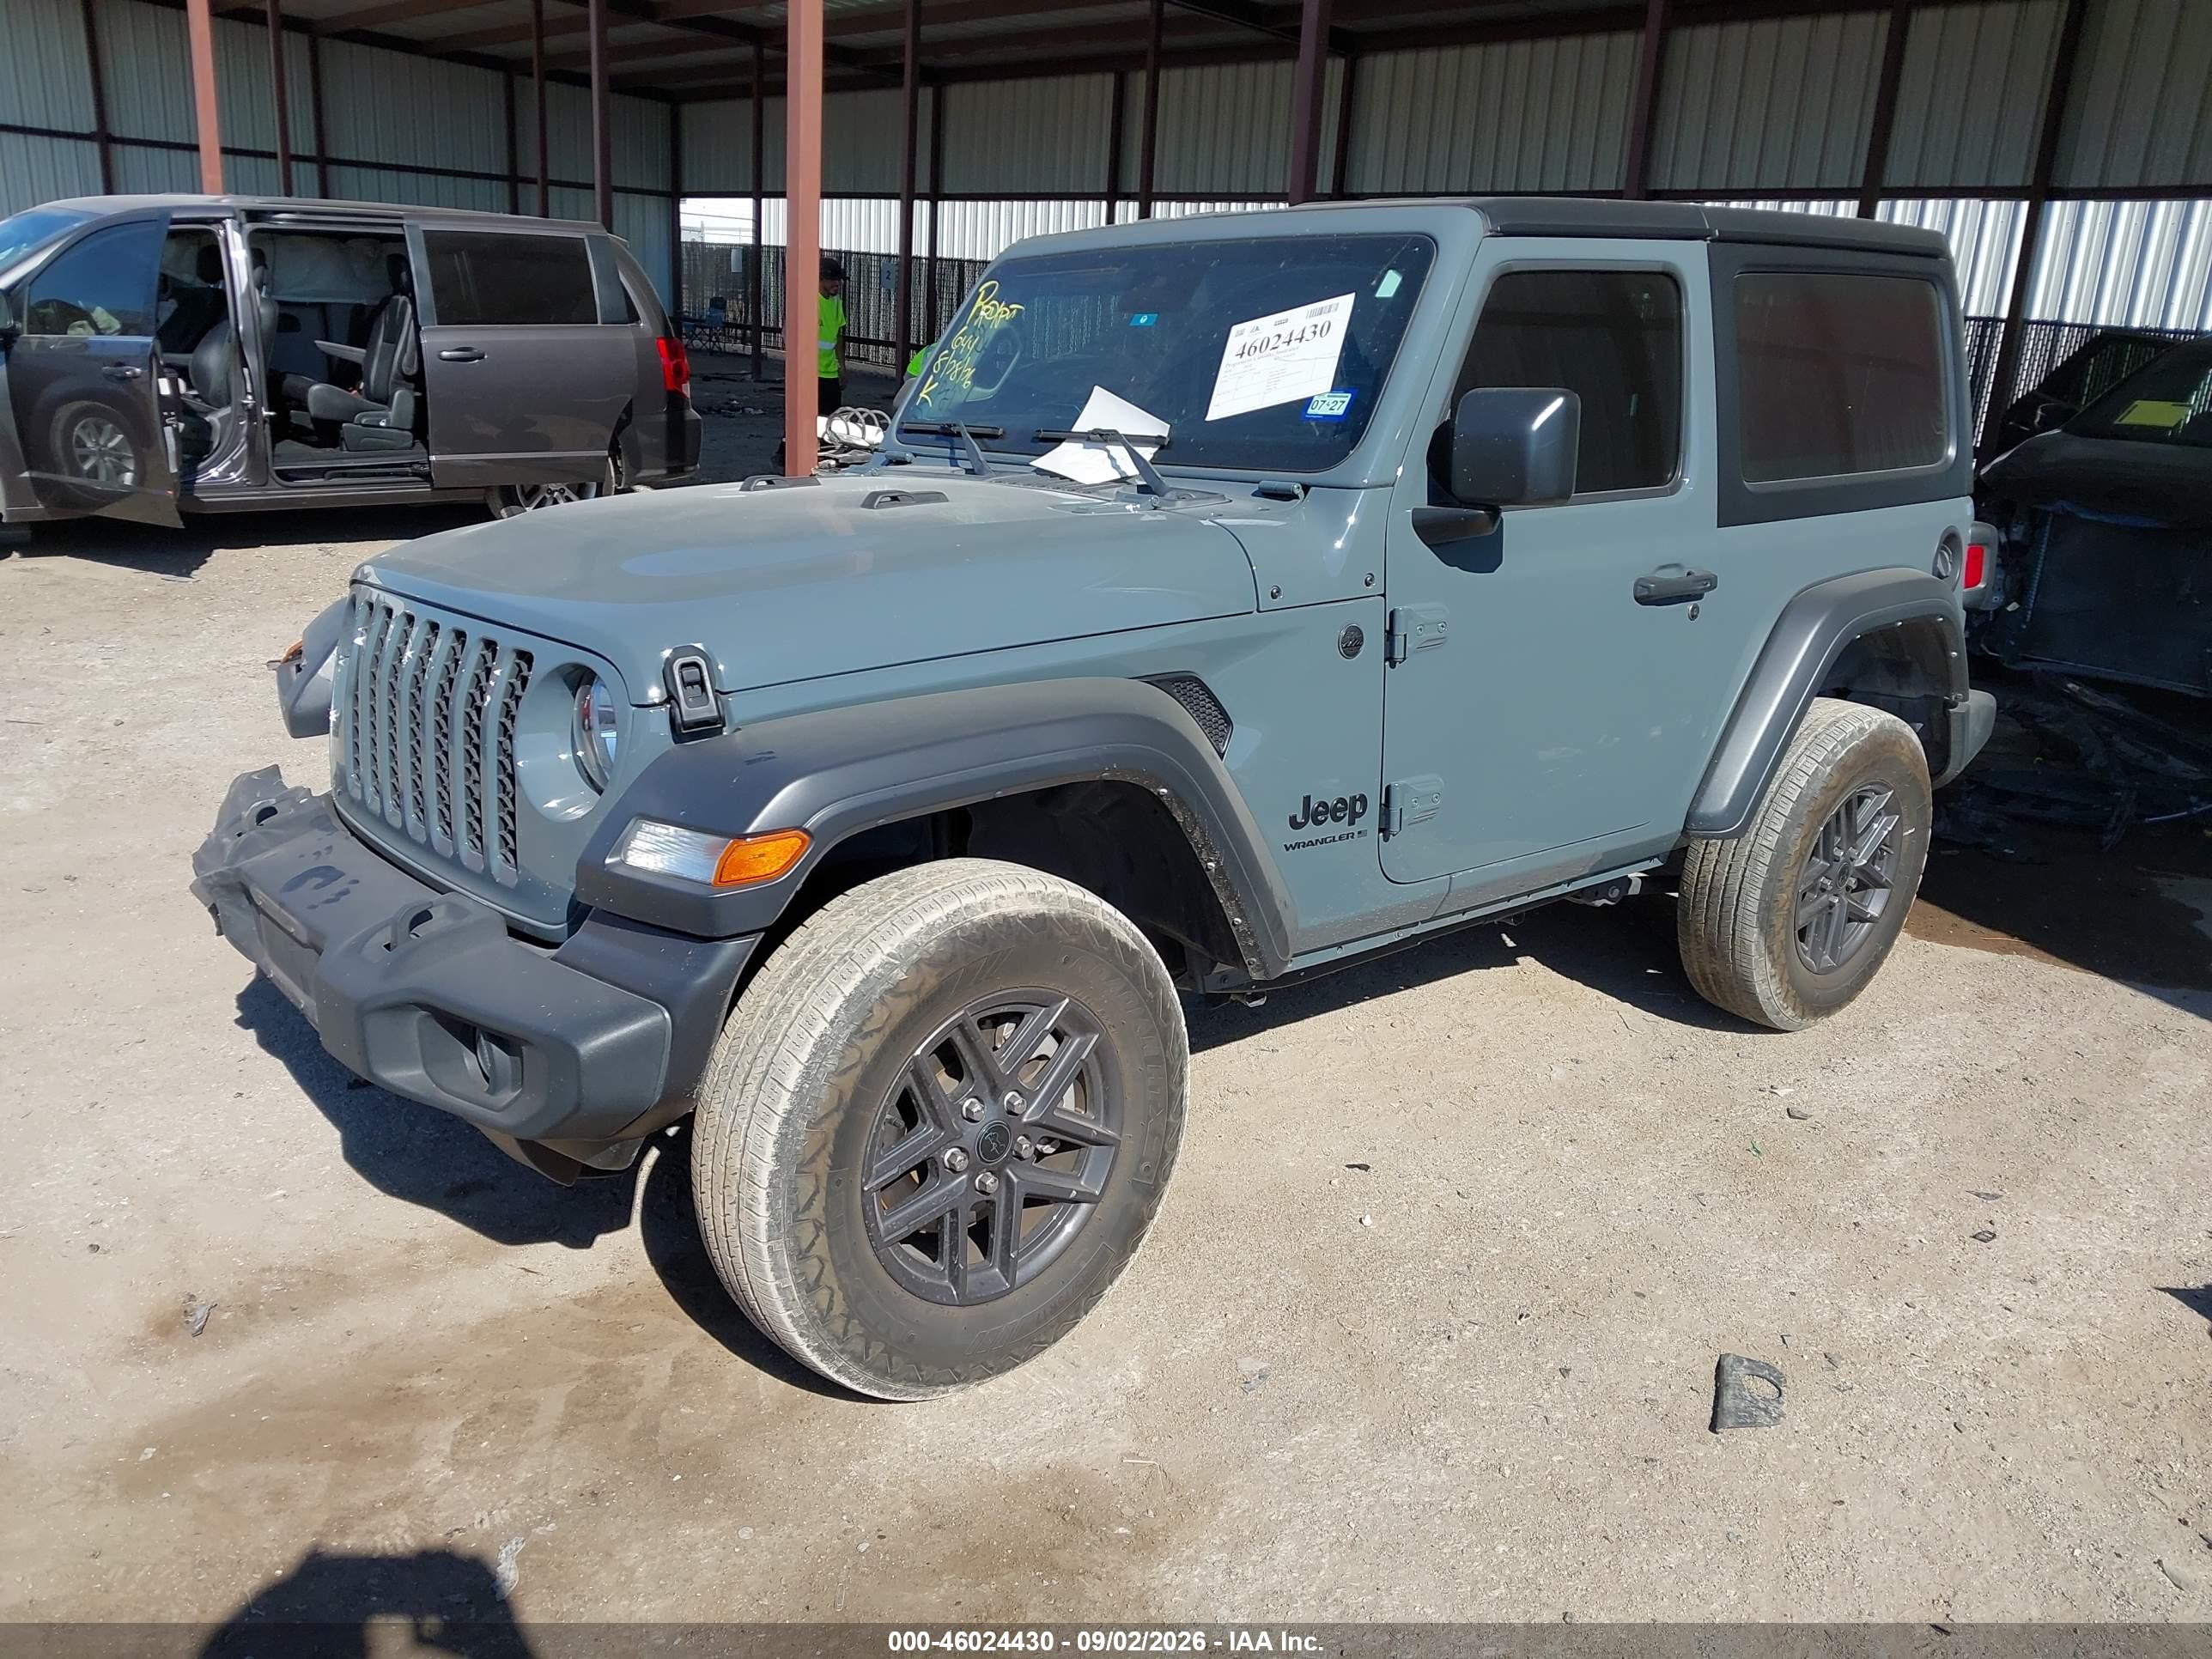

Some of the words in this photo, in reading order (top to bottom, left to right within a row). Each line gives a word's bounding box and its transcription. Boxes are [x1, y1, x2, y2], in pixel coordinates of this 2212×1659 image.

[1234, 319, 1332, 360] 46024430
[916, 374, 939, 408] K
[1288, 793, 1368, 830] Jeep
[1284, 832, 1355, 853] WRANGLER
